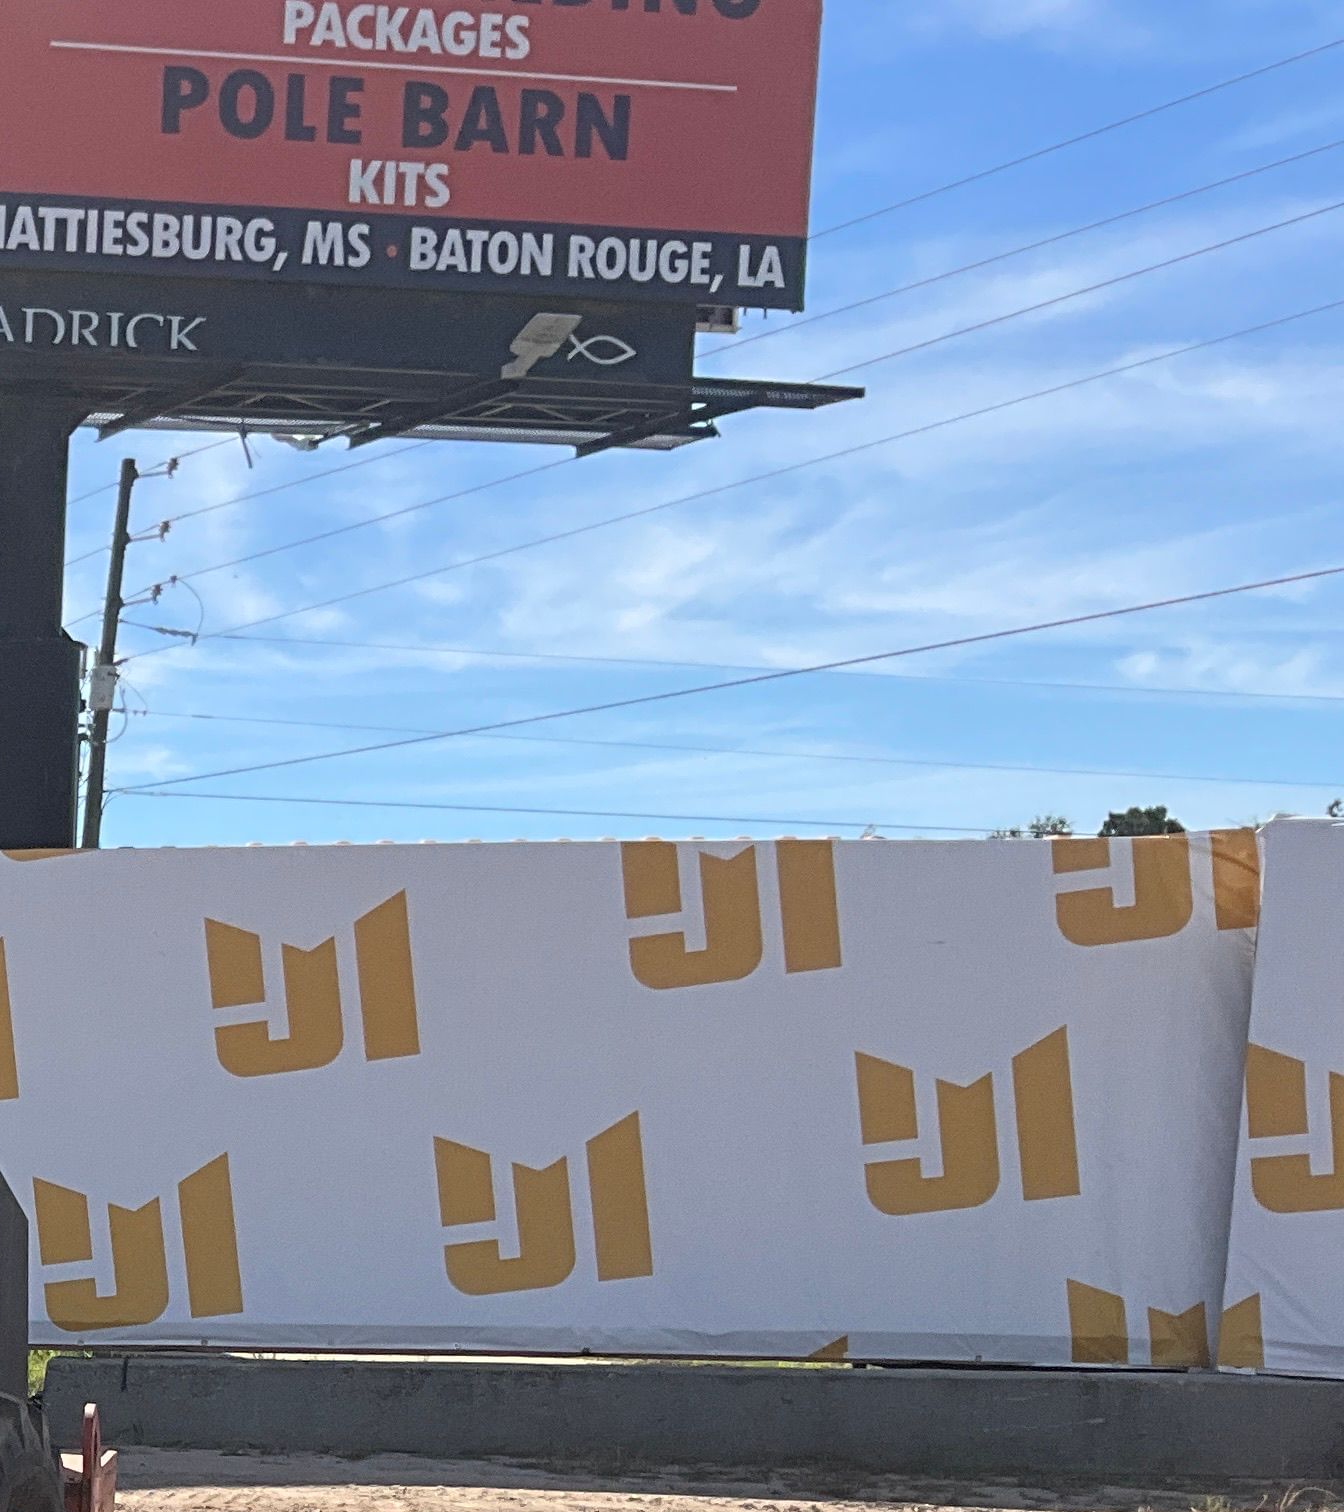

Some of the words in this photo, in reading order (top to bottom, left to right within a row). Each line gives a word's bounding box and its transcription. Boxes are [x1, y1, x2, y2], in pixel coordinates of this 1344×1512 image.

[281, 0, 531, 60] PACKAGES
[160, 65, 364, 146] POLE
[401, 80, 632, 161] BARN
[347, 158, 452, 209] KITS
[301, 221, 372, 268] MS
[408, 227, 555, 276] BATON
[567, 235, 724, 293] ROUGE,
[736, 245, 786, 289] LA
